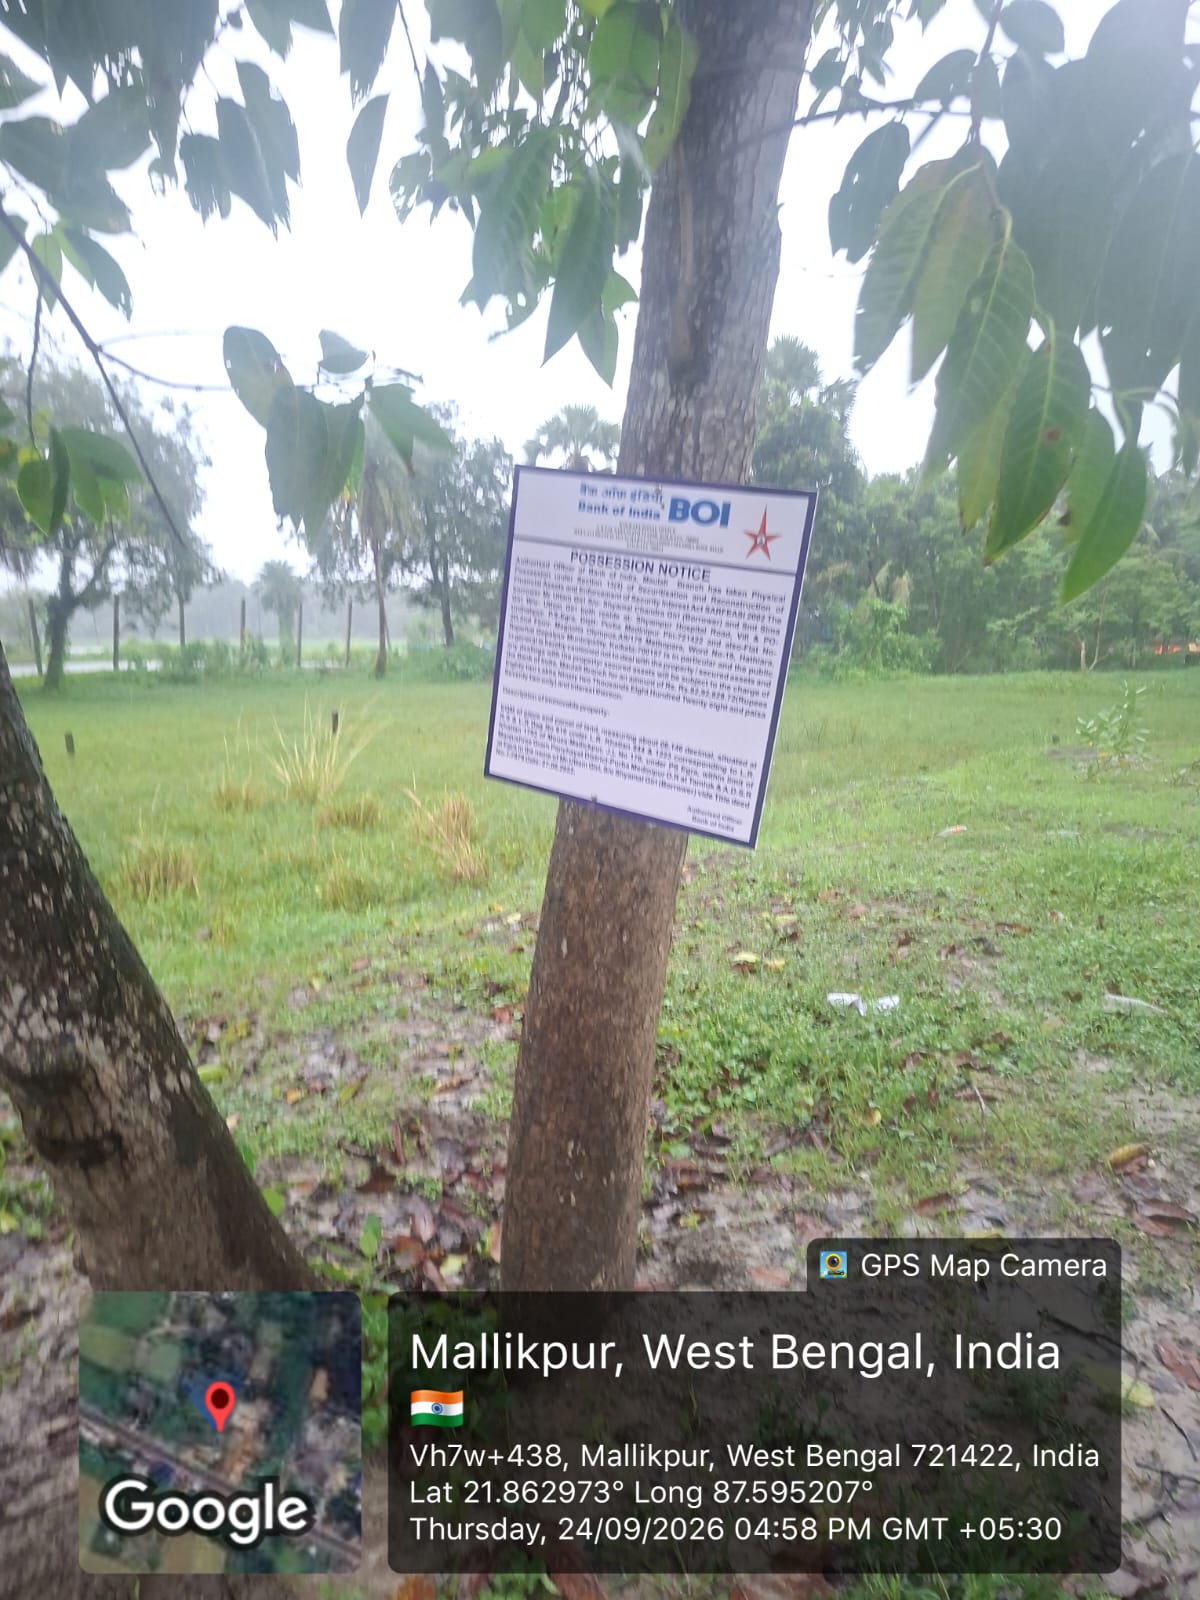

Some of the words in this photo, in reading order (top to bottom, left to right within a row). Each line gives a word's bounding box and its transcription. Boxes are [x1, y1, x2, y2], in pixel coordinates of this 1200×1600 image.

[577, 501, 609, 514] Bank
[612, 505, 625, 516] of
[628, 506, 661, 520] India
[668, 497, 731, 527] BOI
[570, 551, 654, 574] POSSESSION
[657, 563, 711, 582] NOTICE
